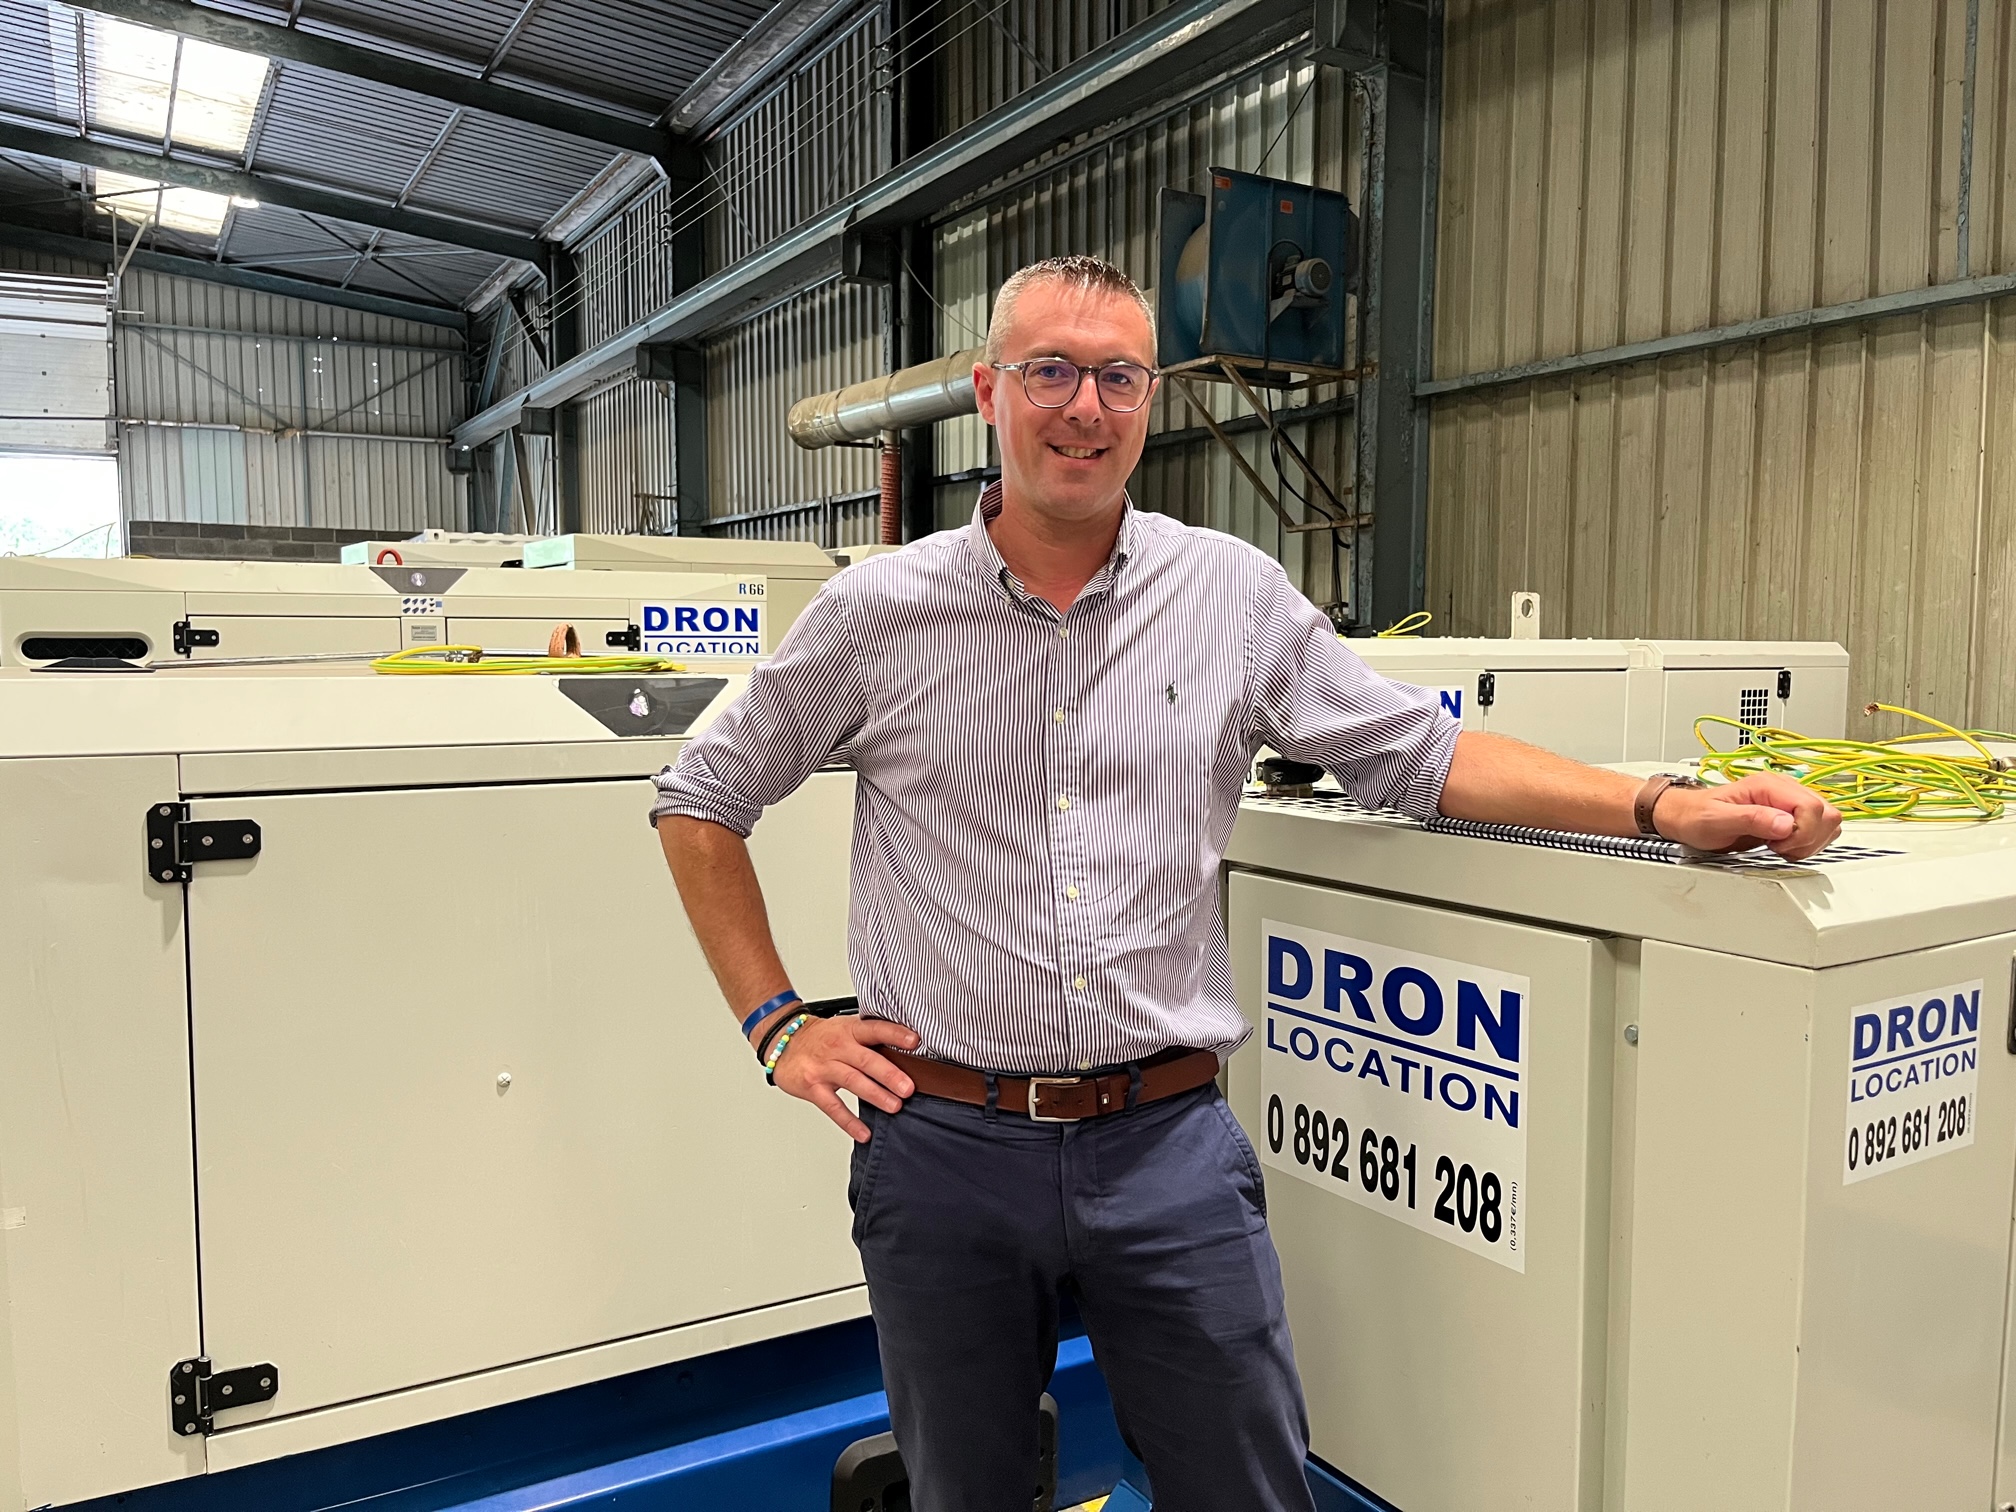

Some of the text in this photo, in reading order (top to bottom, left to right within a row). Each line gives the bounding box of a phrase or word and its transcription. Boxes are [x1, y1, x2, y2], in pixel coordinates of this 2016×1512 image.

[644, 606, 758, 632] DRON
[739, 583, 764, 595] R 66
[644, 642, 759, 654] LOCATION
[1268, 935, 1521, 1063] DRON
[1853, 989, 1980, 1061] DRON
[1267, 1018, 1519, 1129] LOCATION
[1851, 1048, 1976, 1102] LOCATION
[1268, 1094, 1502, 1243] 0 892 681 208
[1849, 1127, 1859, 1171] 0
[1864, 1116, 1897, 1165] 892
[1902, 1105, 1931, 1154] 681
[1937, 1096, 1966, 1143] 208
